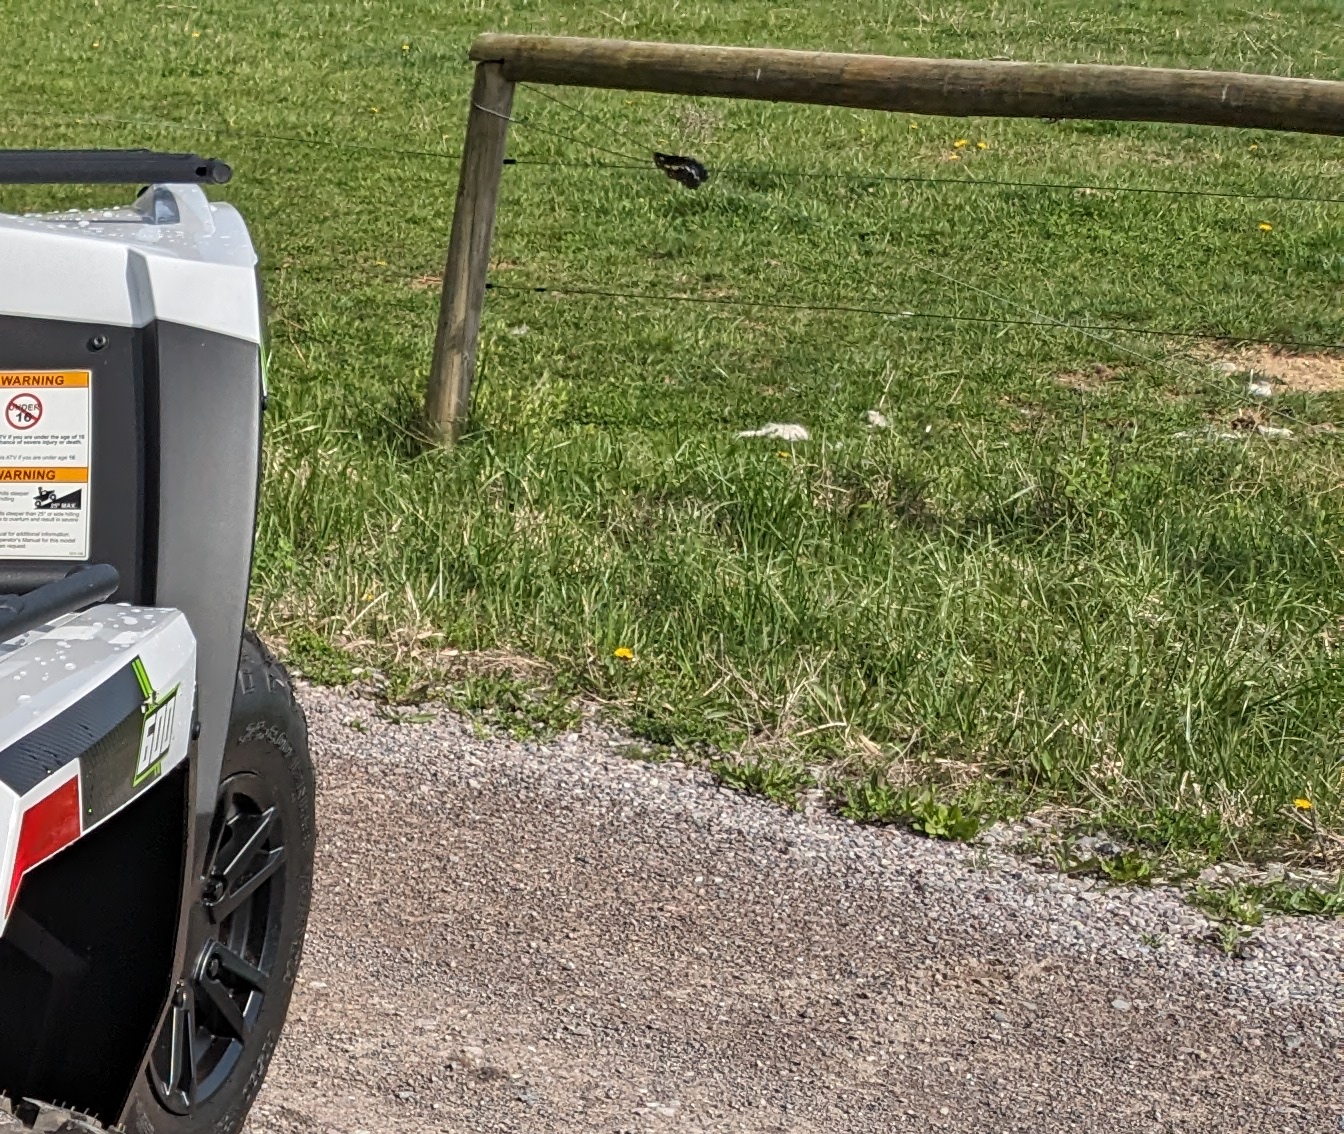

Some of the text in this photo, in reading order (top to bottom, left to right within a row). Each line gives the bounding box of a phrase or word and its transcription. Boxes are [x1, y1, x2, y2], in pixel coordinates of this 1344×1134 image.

[0, 375, 65, 386] WARNING
[9, 403, 40, 412] UNDER
[137, 694, 176, 776] 600
